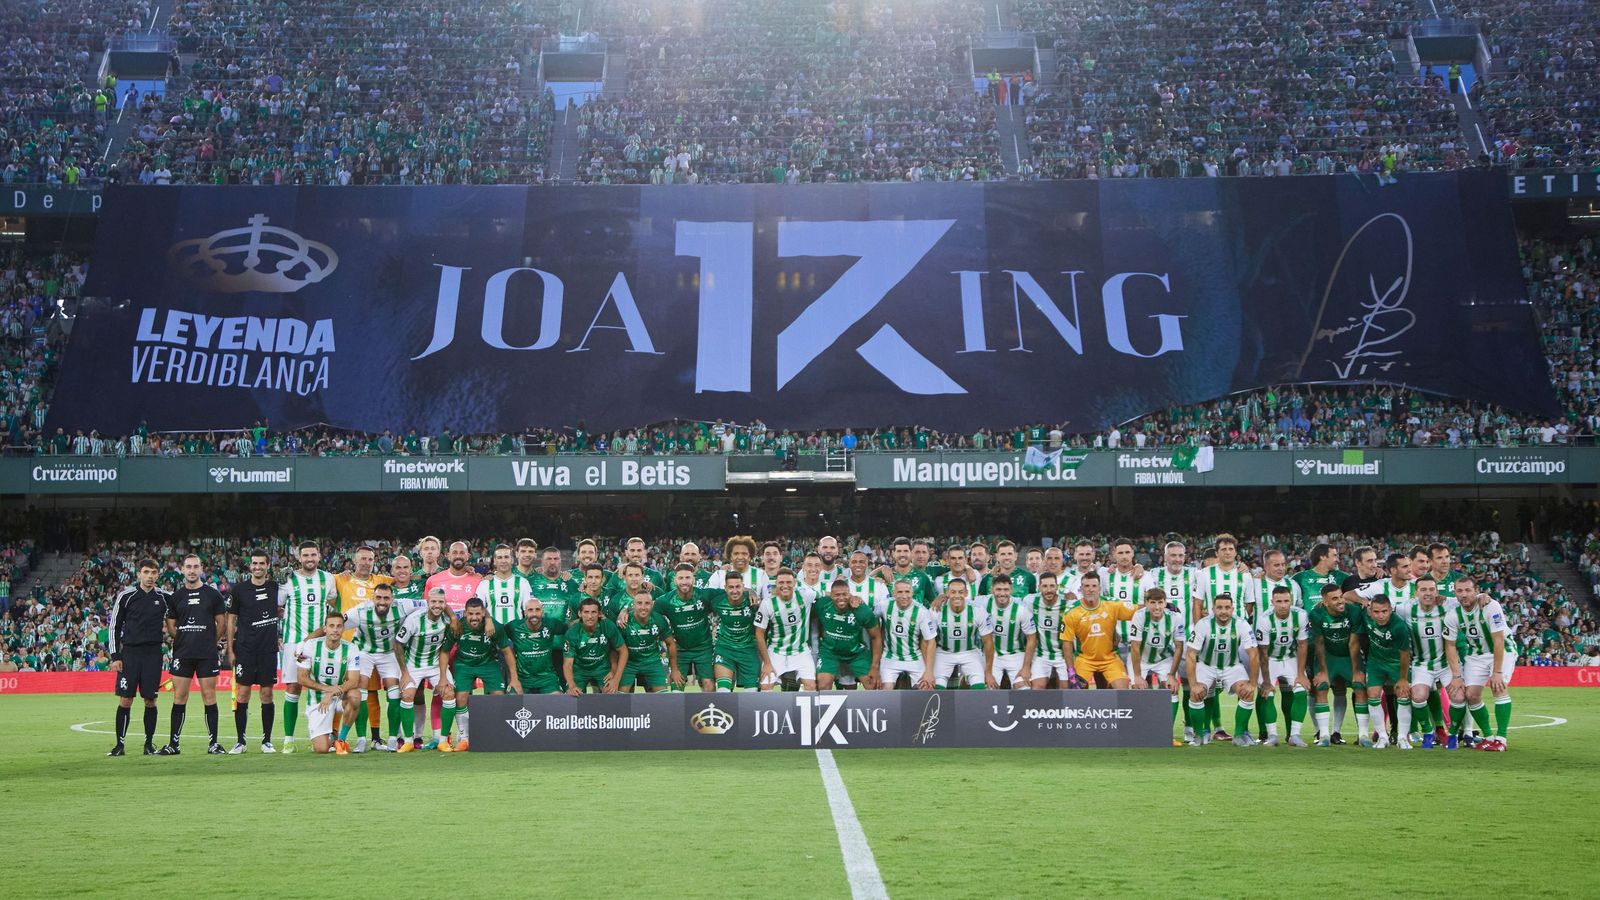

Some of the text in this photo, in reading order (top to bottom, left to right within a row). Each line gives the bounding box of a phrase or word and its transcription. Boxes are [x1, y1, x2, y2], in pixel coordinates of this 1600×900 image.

[14, 190, 53, 208] De
[136, 307, 336, 355] LEYENDA
[131, 346, 329, 396] VERDIBLANCA
[32, 464, 117, 483] Cruzcampo
[230, 467, 290, 482] hummel
[384, 459, 465, 473] finetwork
[511, 460, 690, 486] Viva el Betis
[1317, 460, 1379, 475] hummel
[1476, 458, 1566, 475] Cruzcampo
[400, 476, 449, 489] FIBRA Y MÓVIL
[1135, 470, 1185, 484] FIBRA Y MÓVIL
[546, 713, 651, 732] Real Betis Balompié
[1038, 721, 1118, 730] FUNDACIÓN
